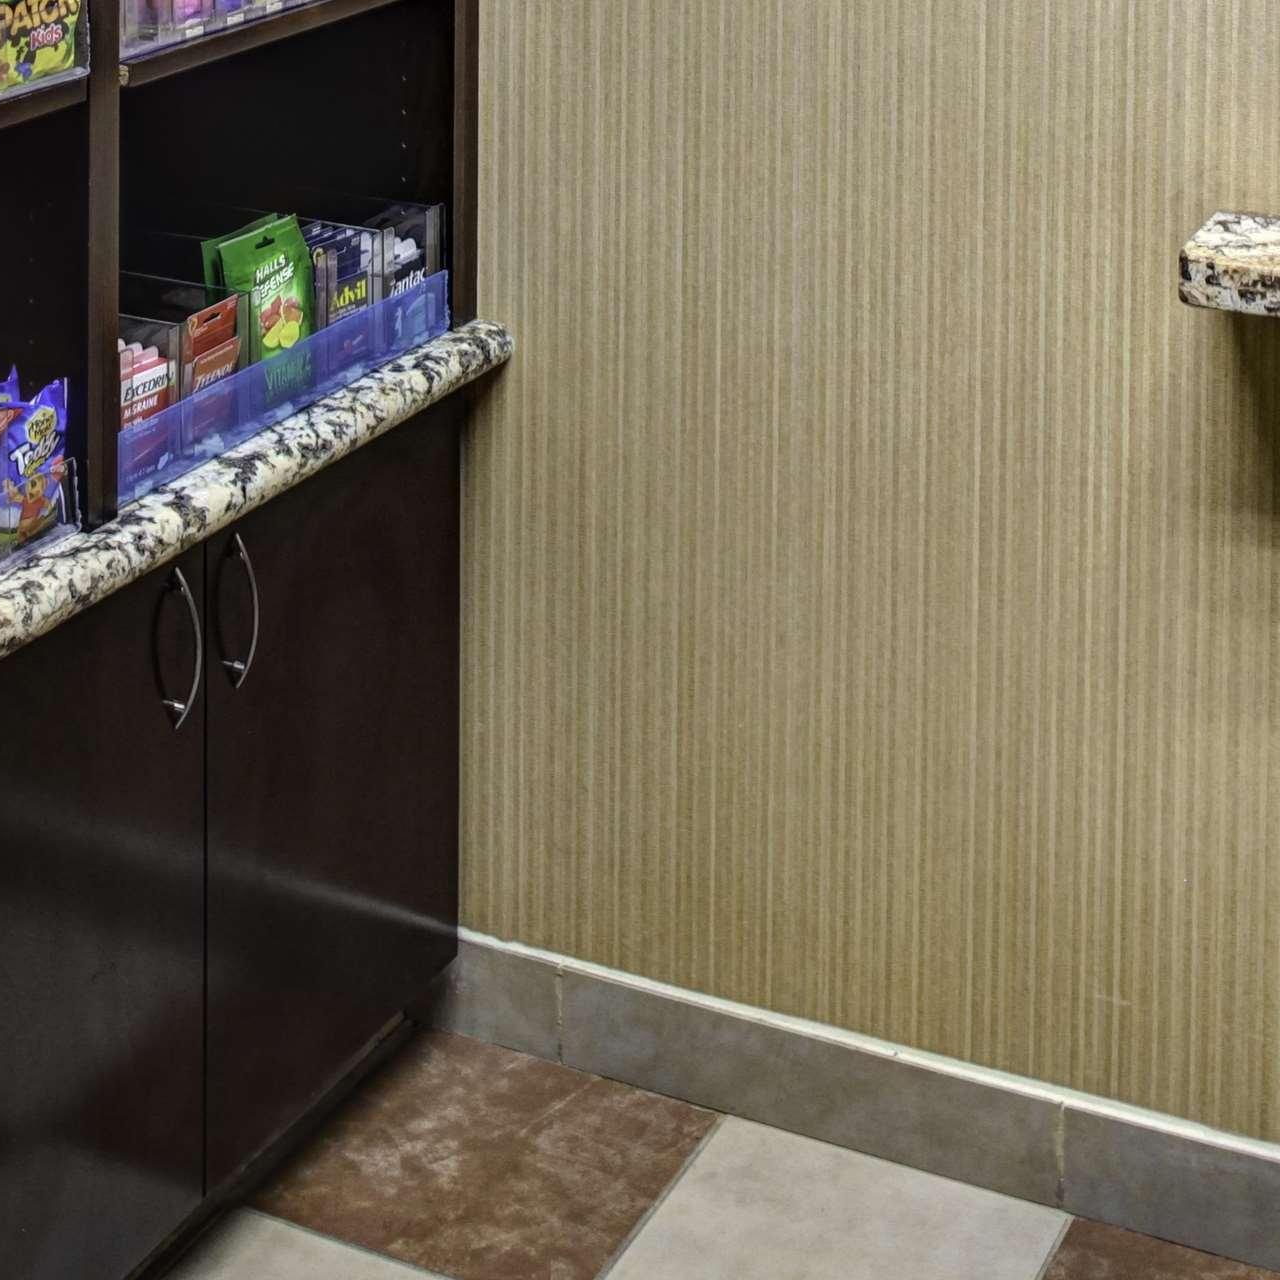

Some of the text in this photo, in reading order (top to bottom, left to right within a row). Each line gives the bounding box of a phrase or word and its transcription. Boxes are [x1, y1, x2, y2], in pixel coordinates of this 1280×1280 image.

[30, 23, 63, 51] Kids
[255, 254, 287, 283] HALLS
[330, 279, 367, 312] Advil
[124, 371, 174, 404] EXCEDRIN
[9, 431, 61, 475] Teddy
